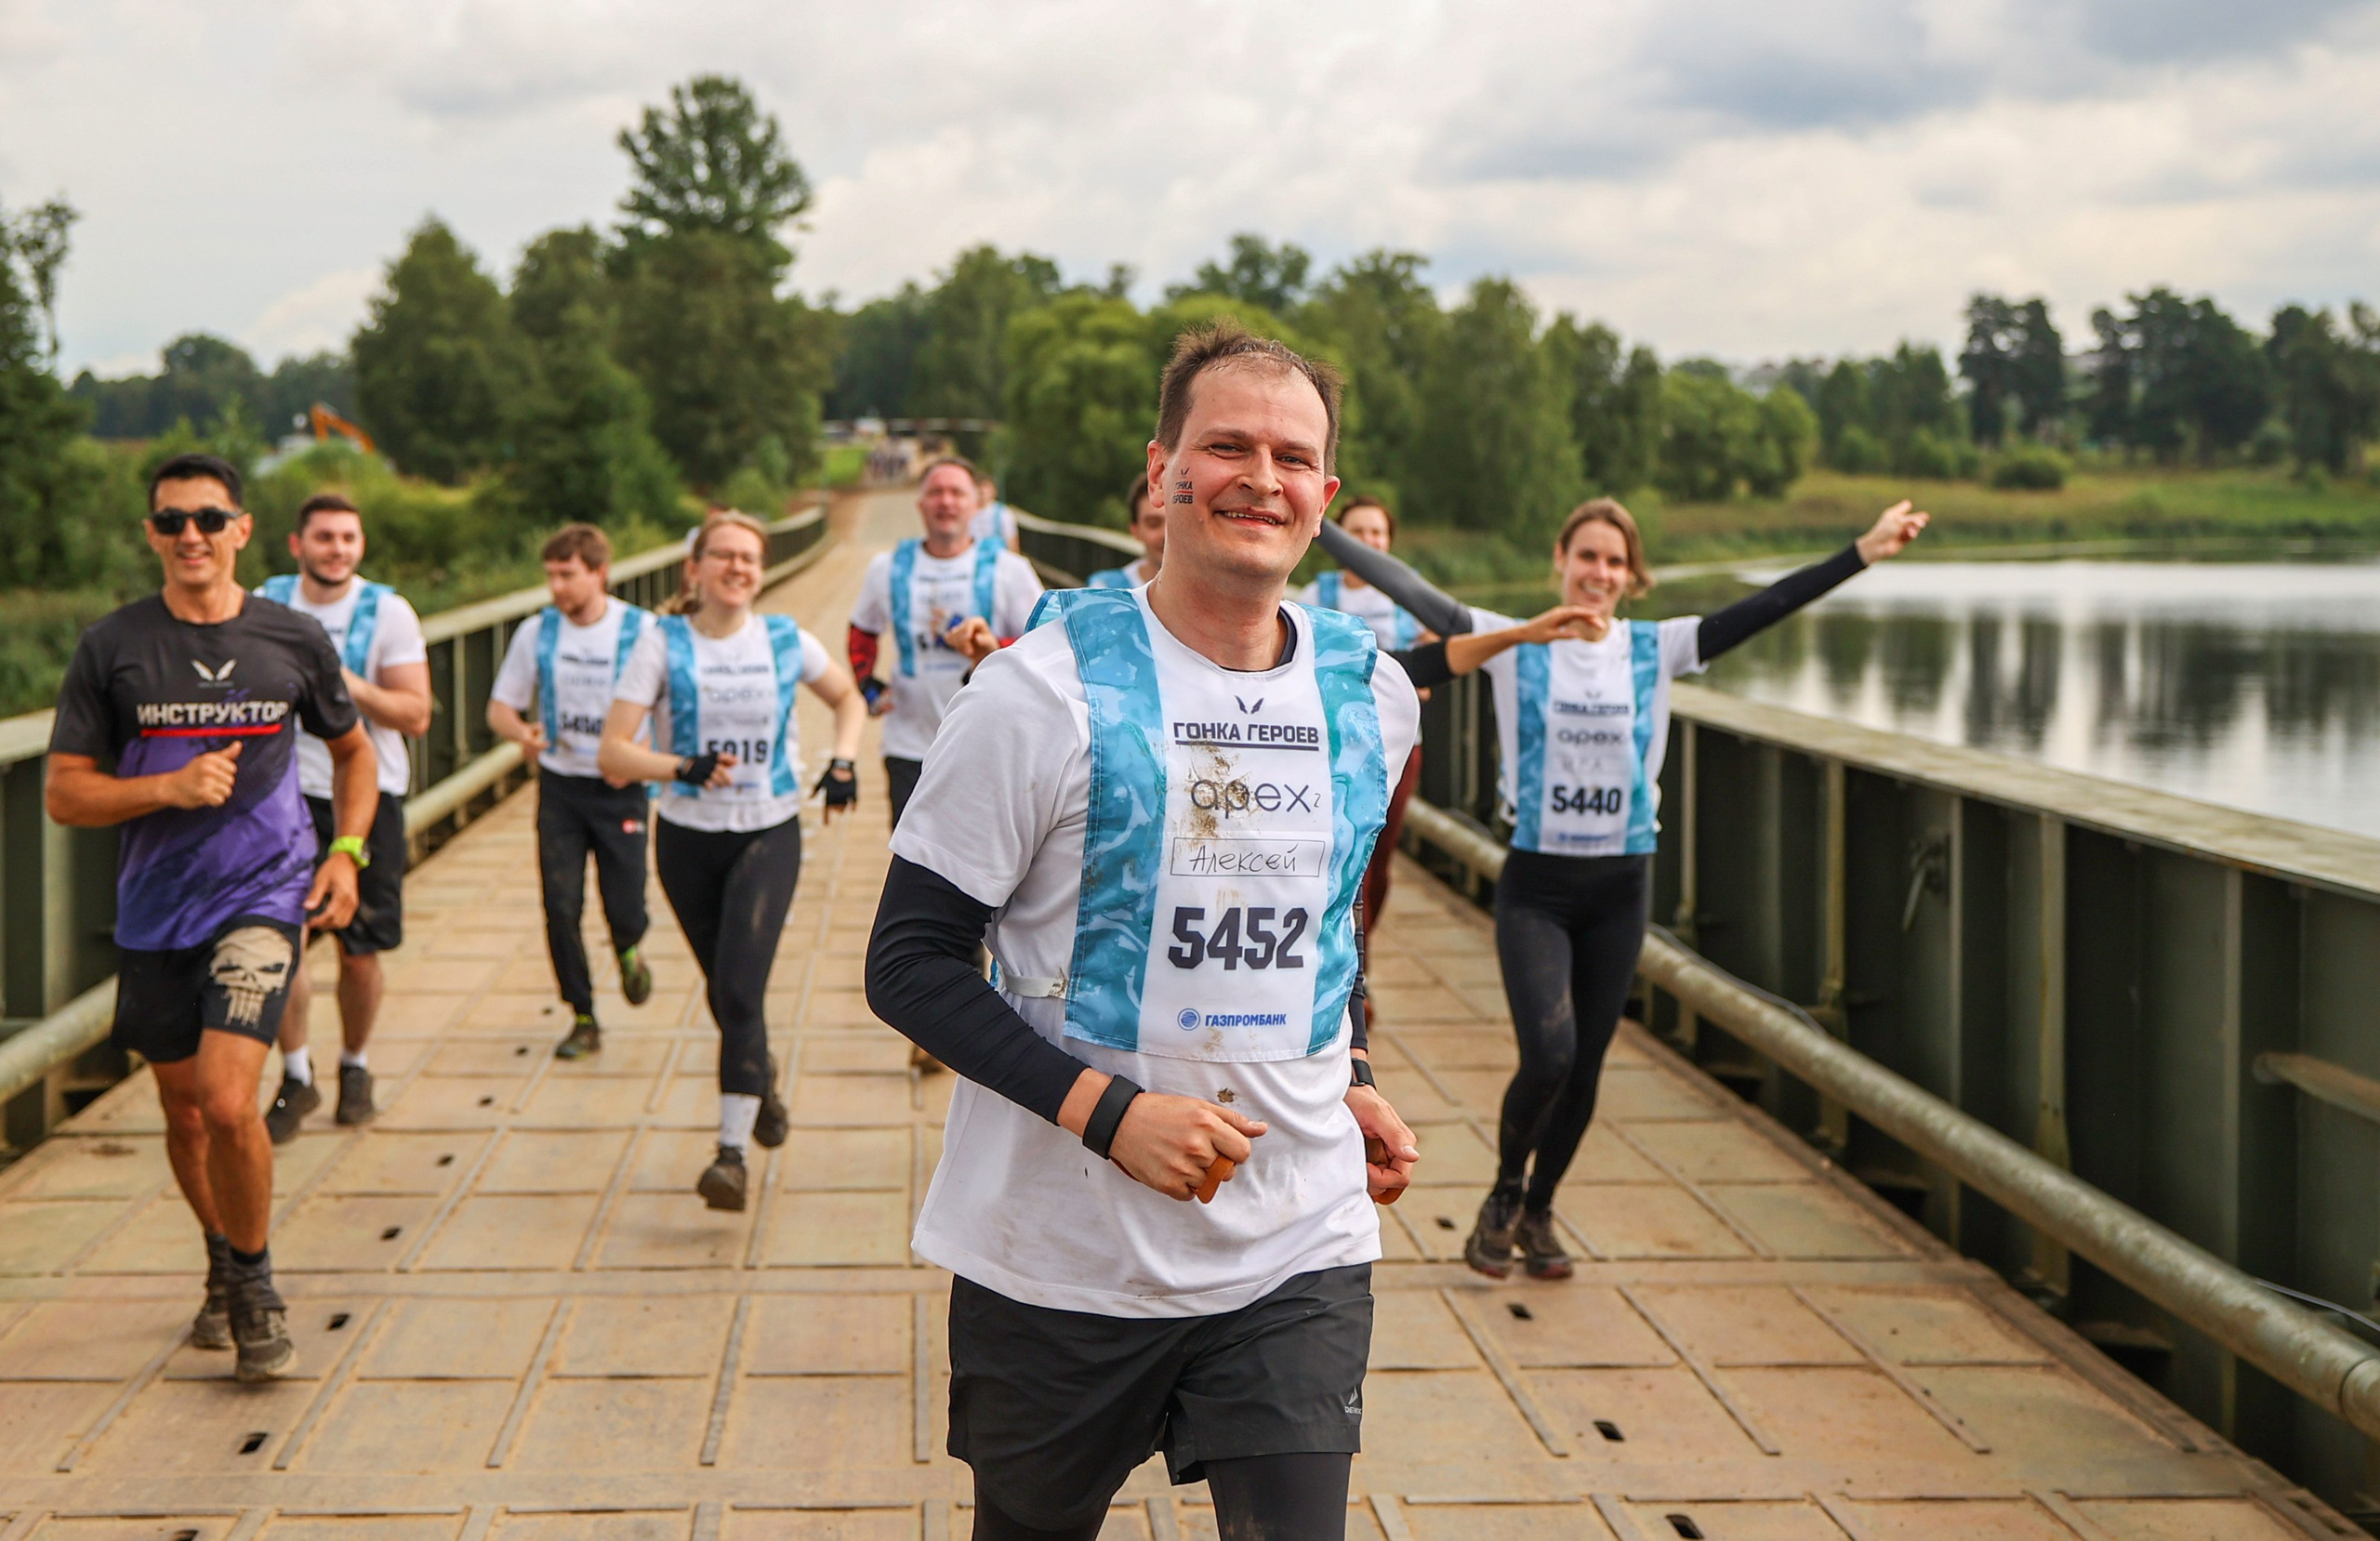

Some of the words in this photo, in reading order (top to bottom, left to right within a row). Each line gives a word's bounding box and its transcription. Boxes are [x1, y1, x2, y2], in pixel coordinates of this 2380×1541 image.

[136, 700, 289, 725] ИНСТРУКТОР
[1173, 722, 1241, 741] ГОНКА
[1247, 723, 1319, 744] ГЕРОЕВ
[1557, 728, 1621, 747] apex
[1191, 779, 1311, 819] apex
[1552, 785, 1621, 816] 5440
[1189, 843, 1299, 874] Алексей
[1168, 906, 1309, 970] 5452
[1205, 1014, 1288, 1027] ГАЗПРОМБАНК
